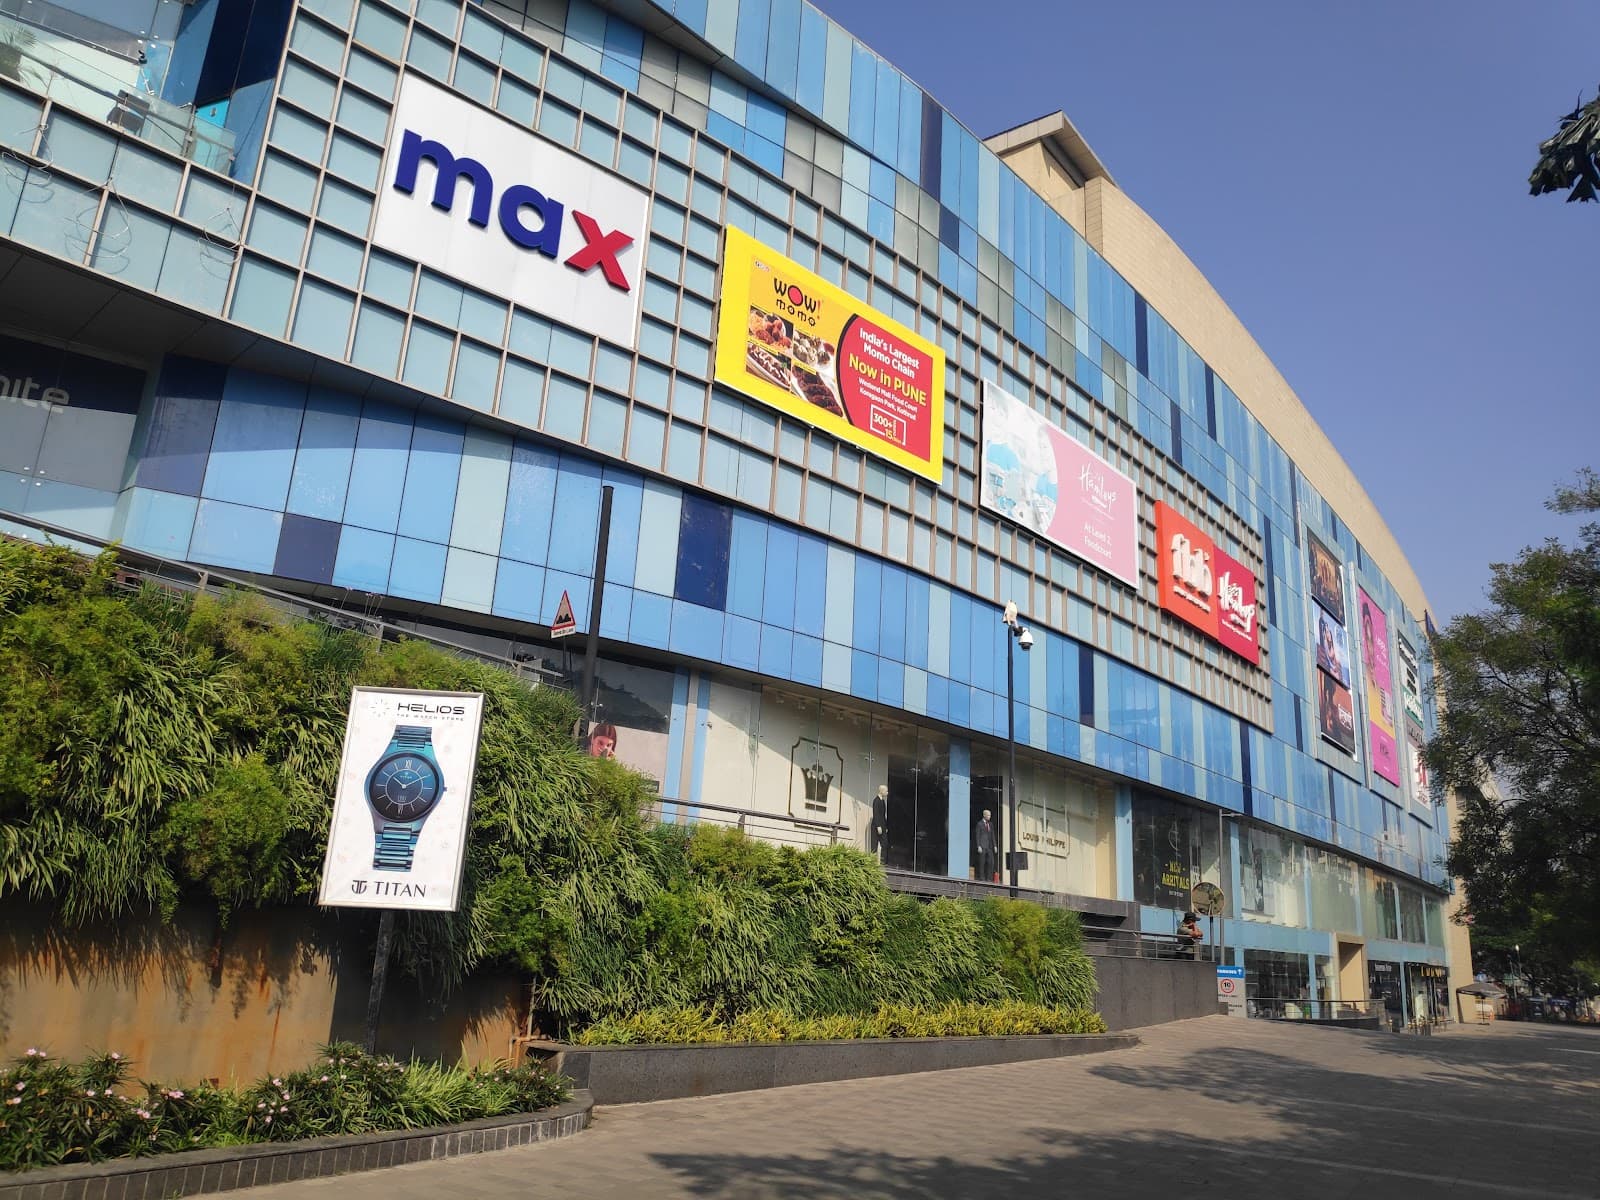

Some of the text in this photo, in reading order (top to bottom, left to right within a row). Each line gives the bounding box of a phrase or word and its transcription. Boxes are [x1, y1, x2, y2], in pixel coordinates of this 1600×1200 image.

[392, 128, 636, 292] max
[859, 327, 920, 370] India's Largest
[863, 342, 915, 379] Momo Chain
[849, 352, 927, 406] Now in PUNE
[891, 393, 904, 407] Food
[904, 400, 918, 414] Court
[873, 412, 893, 429] 300+
[397, 702, 465, 715] HELIOS
[1022, 831, 1040, 842] LOUIS
[374, 881, 427, 898] TITAN
